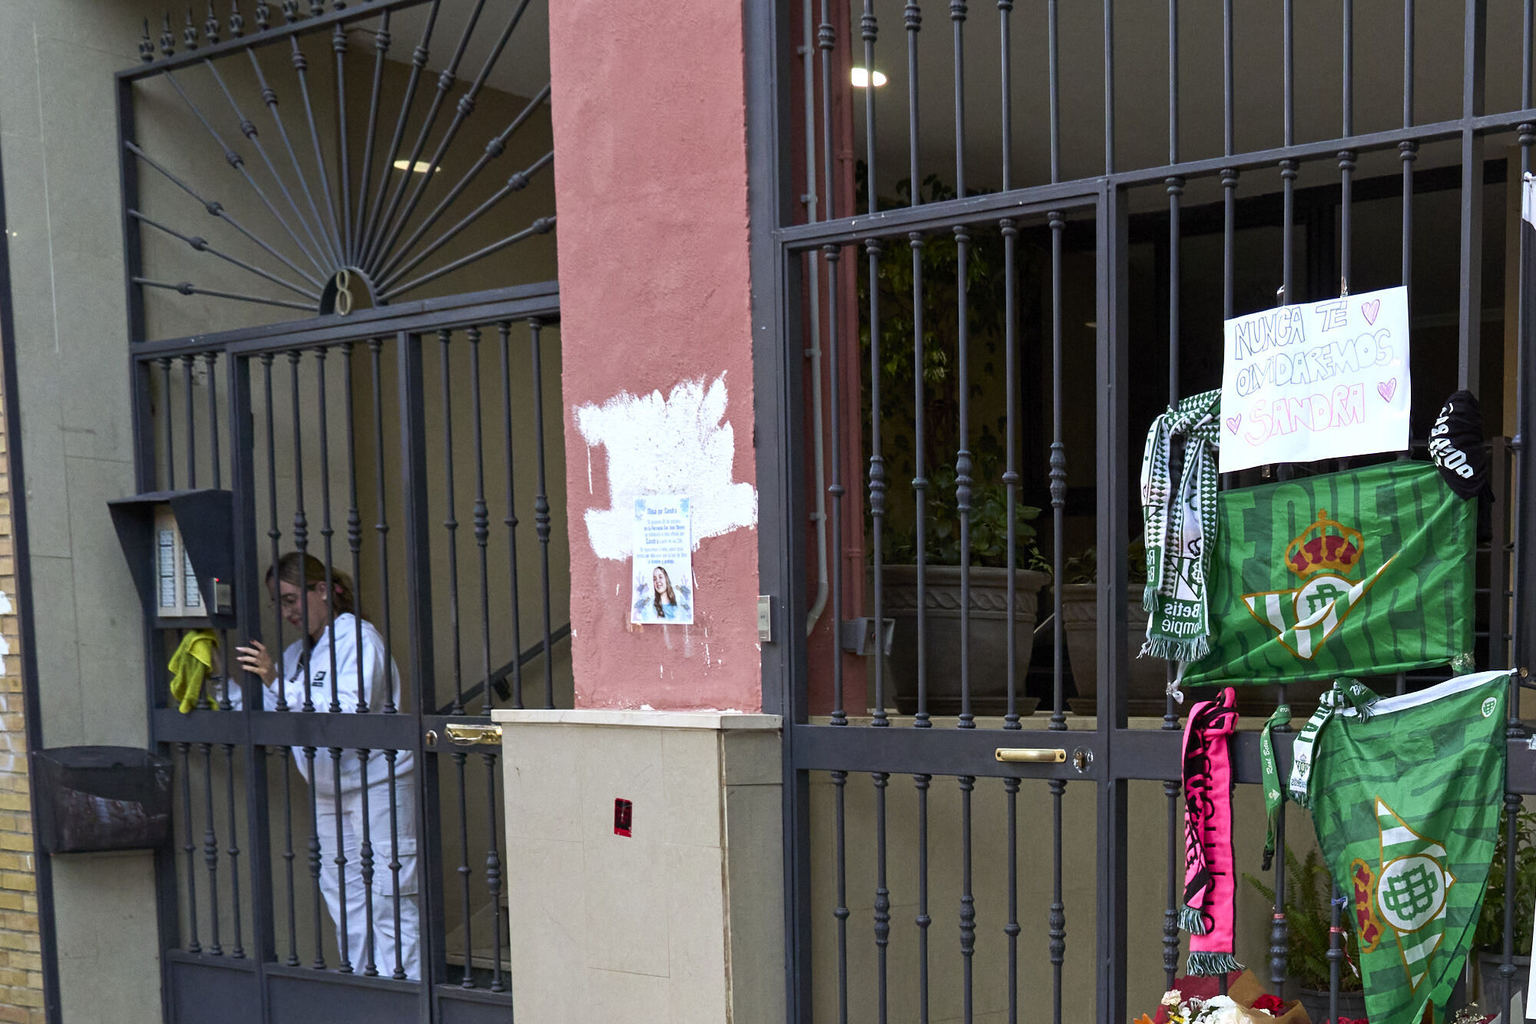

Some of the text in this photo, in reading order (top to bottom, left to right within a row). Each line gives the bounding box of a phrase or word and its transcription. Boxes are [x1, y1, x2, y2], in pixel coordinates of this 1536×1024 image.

[1234, 298, 1348, 360] NUNCA TE
[1235, 328, 1395, 397] OLVIDAREMOS
[1244, 382, 1365, 447] SANDRA
